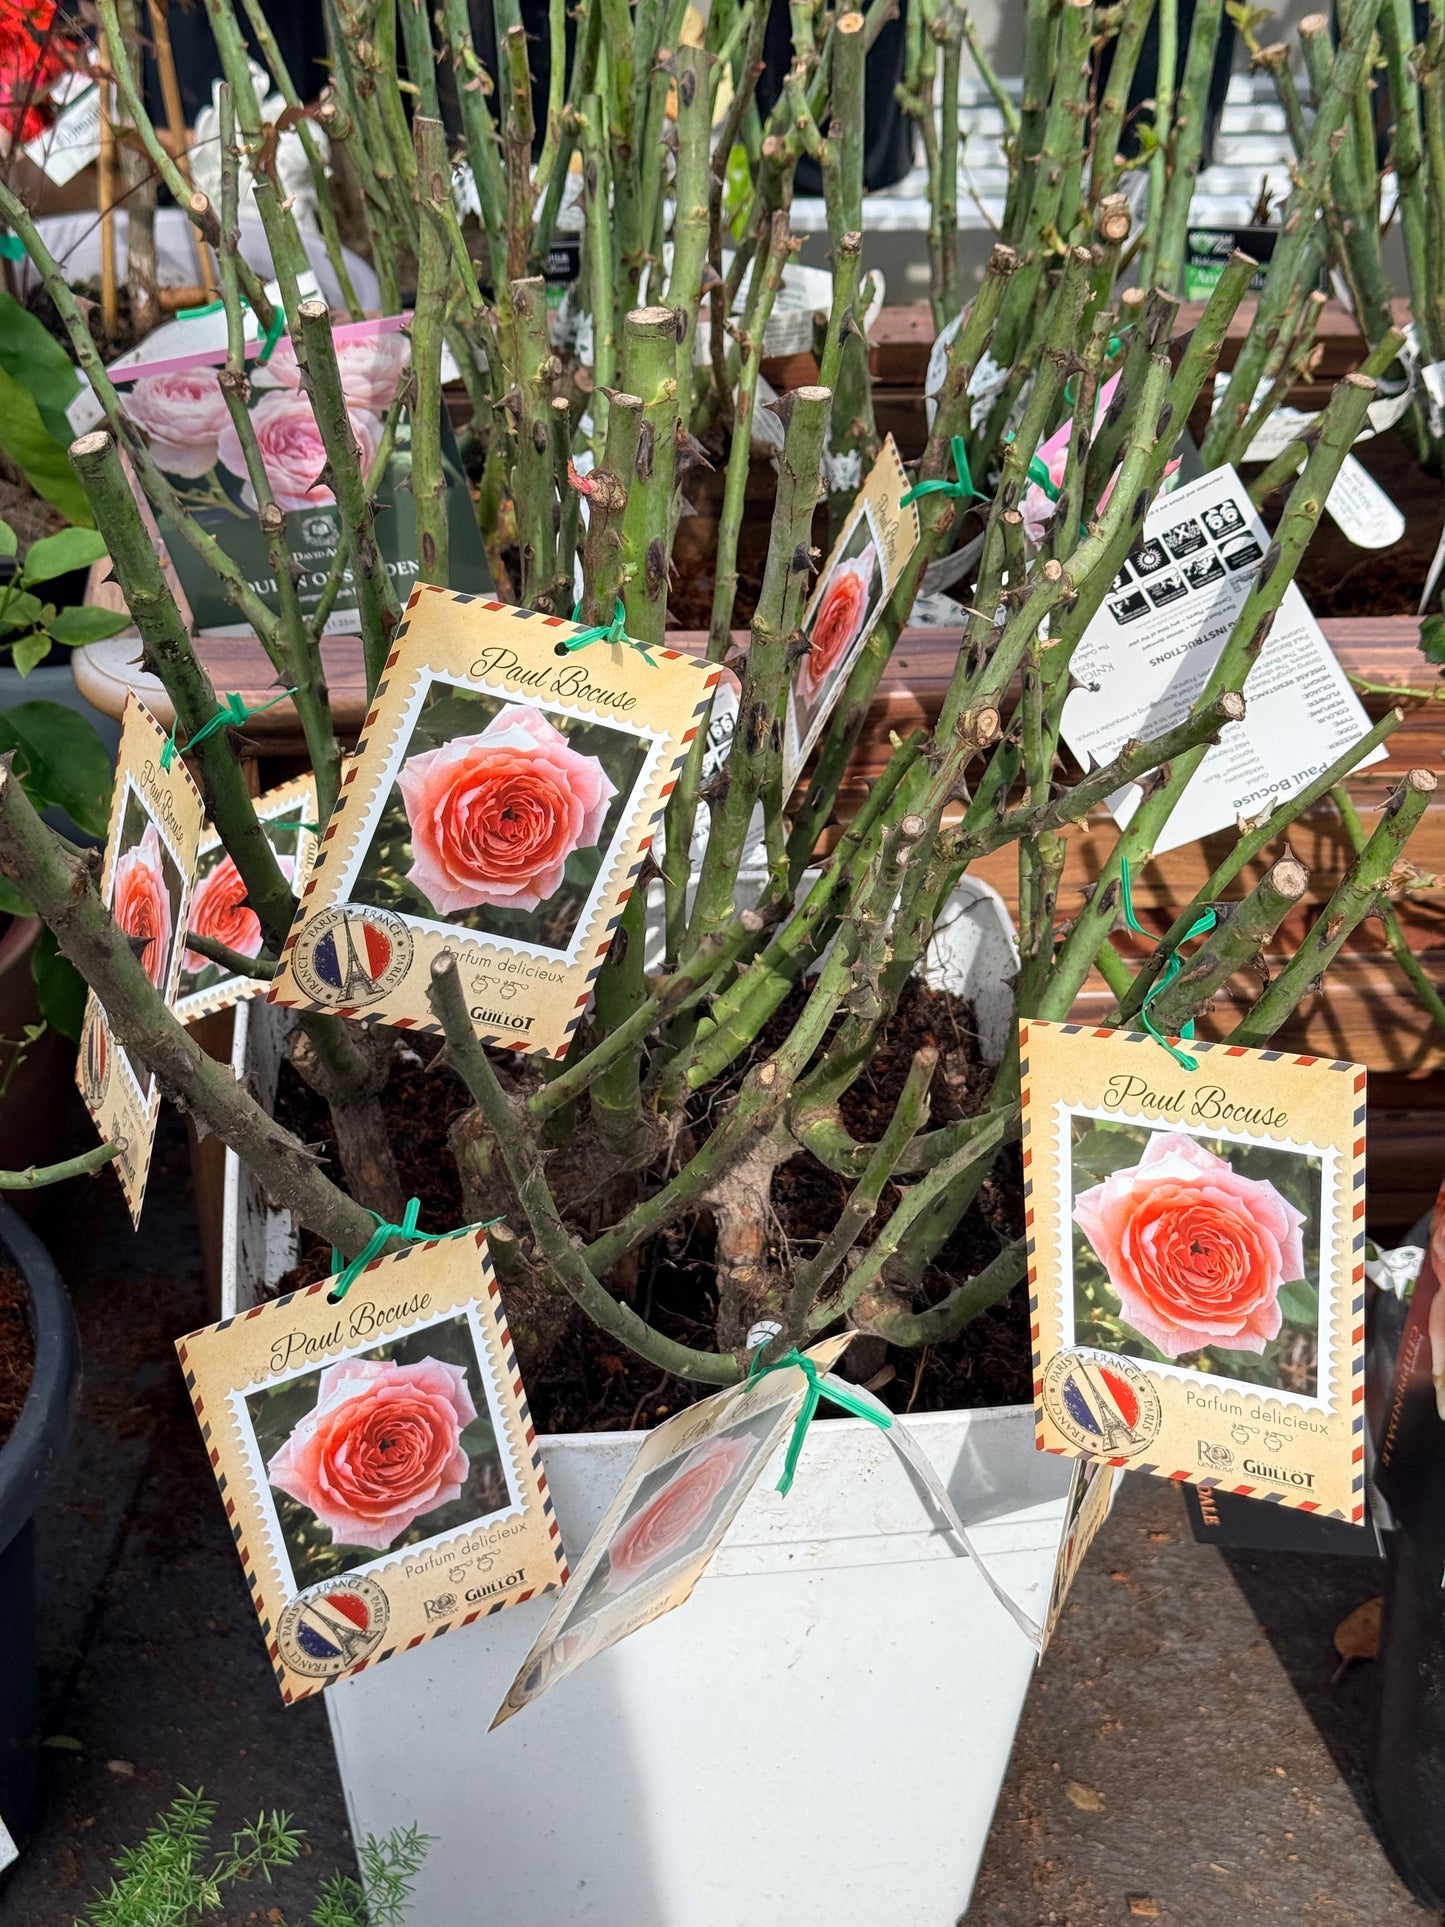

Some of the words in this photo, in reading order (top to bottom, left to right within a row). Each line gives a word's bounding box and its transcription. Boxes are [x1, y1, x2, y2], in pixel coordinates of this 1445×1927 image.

[1148, 625, 1227, 666] INSTRUCTIONS
[470, 647, 552, 687] Paul
[550, 665, 637, 711] Bocuse
[1295, 664, 1325, 681] DISEASE
[140, 760, 163, 807] Paul
[1291, 761, 1328, 784] Paul
[1232, 778, 1290, 811] Bocuse
[308, 912, 339, 938] PARIS
[363, 908, 403, 938] FRANCE
[386, 954, 406, 984] PARIS
[497, 958, 566, 984] delicieux
[470, 1006, 535, 1030] GUILLOT
[1104, 1075, 1185, 1112] Paul
[1191, 1085, 1289, 1128] Bocuse
[270, 1329, 344, 1372] Paul
[350, 1293, 432, 1339] Bocuse
[1050, 1357, 1072, 1383] PARIS
[1093, 1352, 1140, 1384] FRANCE
[1143, 1400, 1155, 1432] PARIS
[1186, 1391, 1242, 1416] Parfum
[1250, 1405, 1329, 1435] delicieux
[1243, 1459, 1315, 1487] GUILLOT
[405, 1552, 455, 1578] Parfum
[462, 1522, 527, 1555] delicieux
[316, 1579, 363, 1593] FRANCE
[465, 1568, 525, 1602] GUILLOT
[283, 1607, 300, 1636] PARIS
[371, 1595, 383, 1624] PARIS
